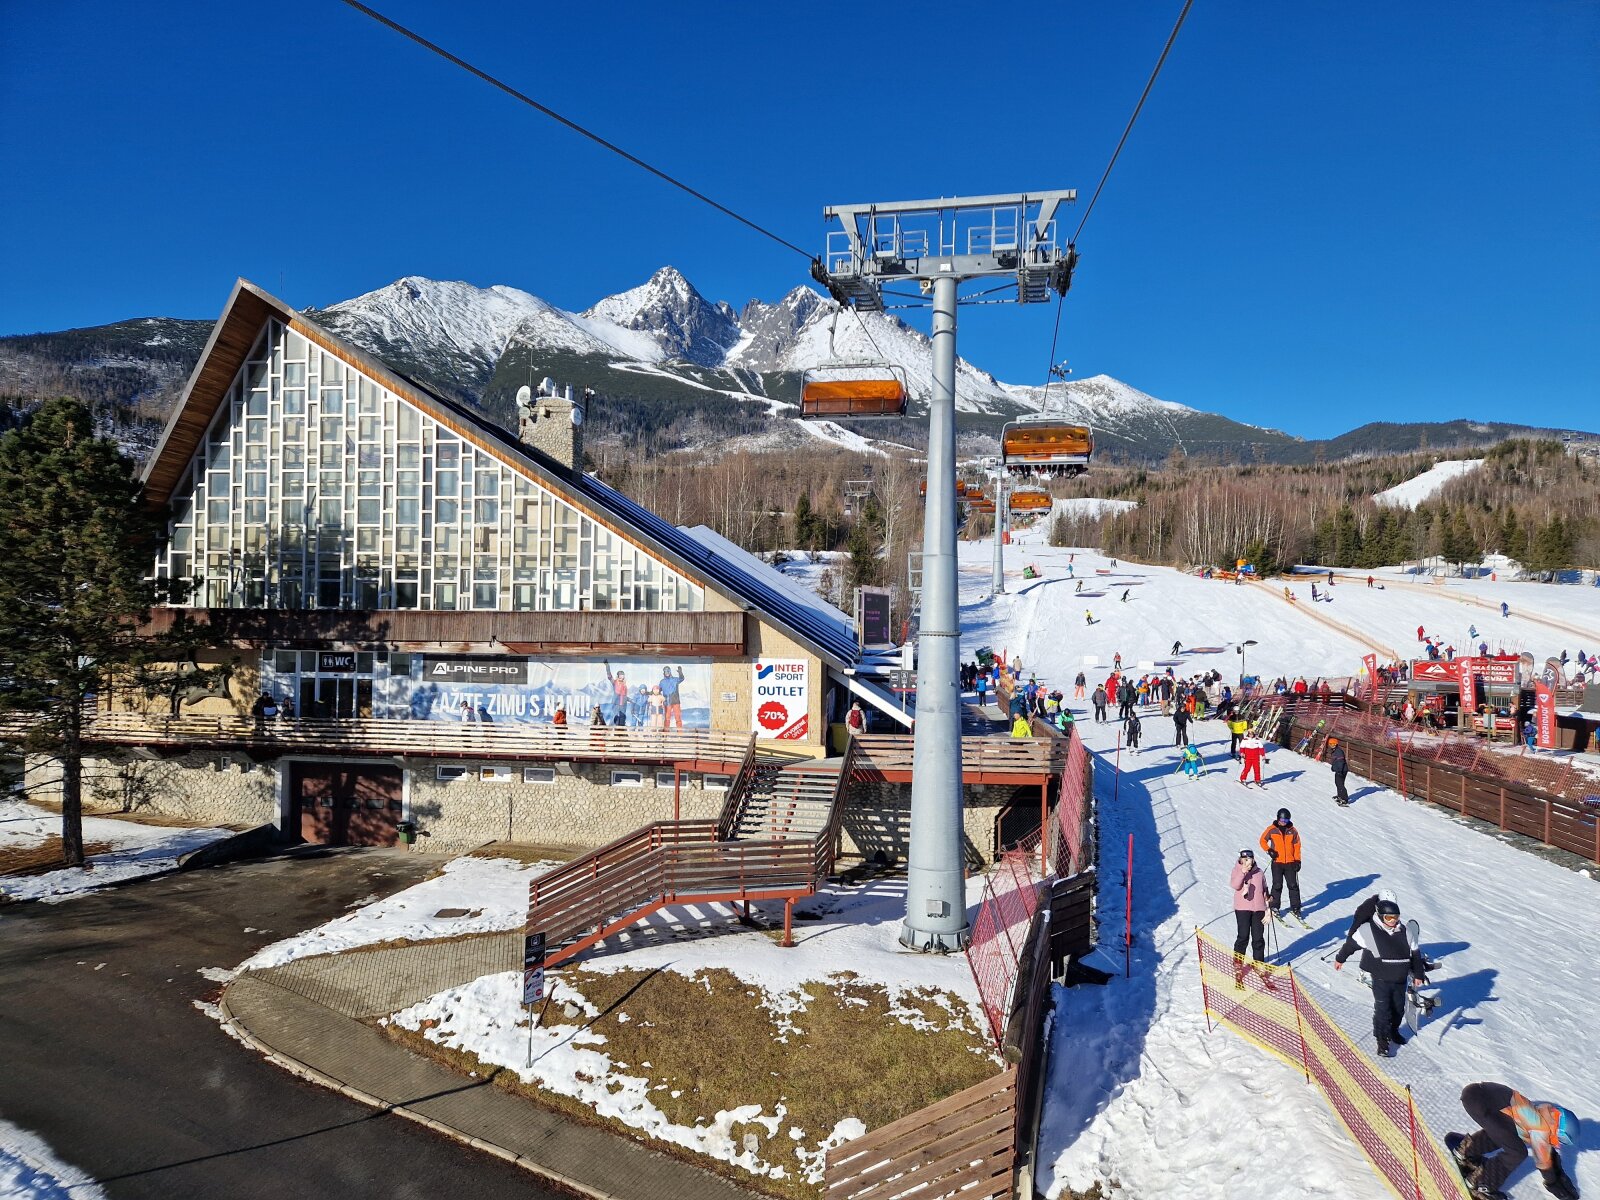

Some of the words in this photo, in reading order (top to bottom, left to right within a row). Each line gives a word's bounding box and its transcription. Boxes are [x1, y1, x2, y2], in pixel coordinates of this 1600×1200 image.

[335, 656, 351, 666] WC
[432, 662, 487, 675] ALPINE
[489, 666, 519, 674] PRO
[775, 664, 804, 672] INTER
[775, 672, 804, 680] SPORT
[1461, 660, 1472, 702] ŠKOLA
[758, 686, 804, 696] OUTLET
[487, 693, 526, 716] ZIMU
[529, 694, 540, 716] S
[760, 711, 786, 720] -70%
